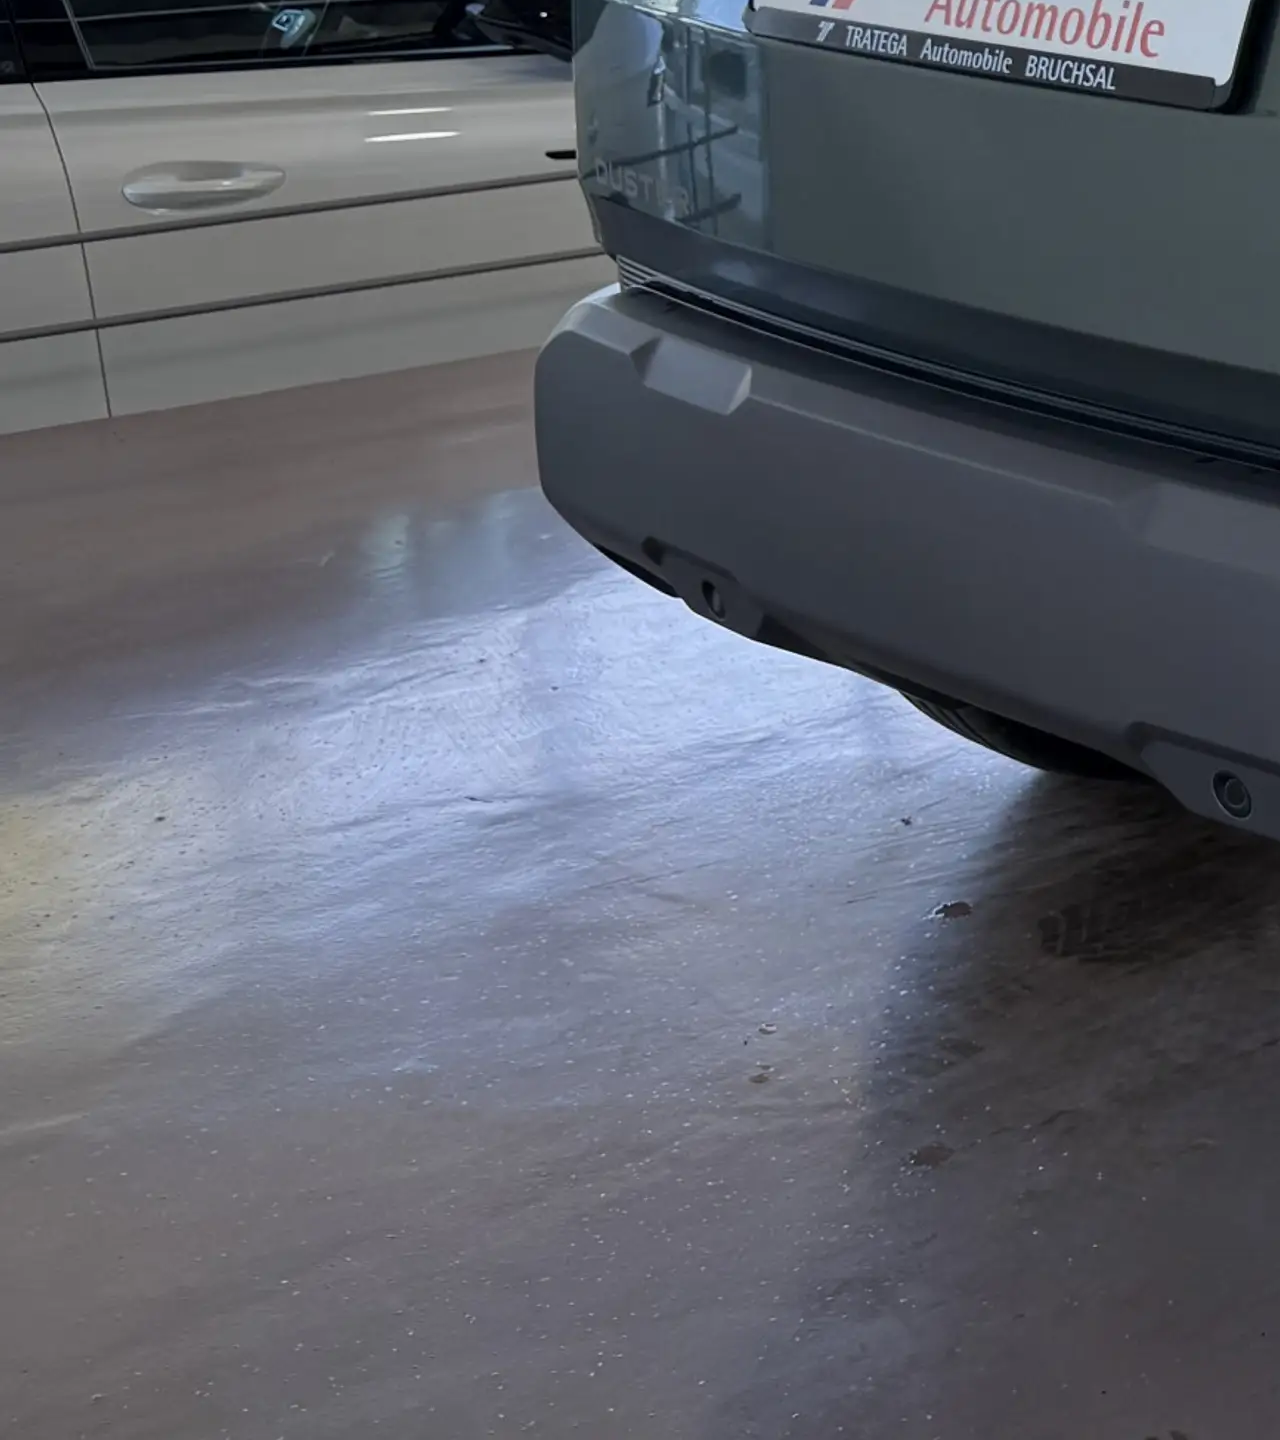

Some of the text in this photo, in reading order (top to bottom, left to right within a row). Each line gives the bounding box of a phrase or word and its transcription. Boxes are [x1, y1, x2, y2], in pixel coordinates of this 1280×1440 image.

[845, 24, 1117, 92] TRATEGA Automobile BRUCHSAL
